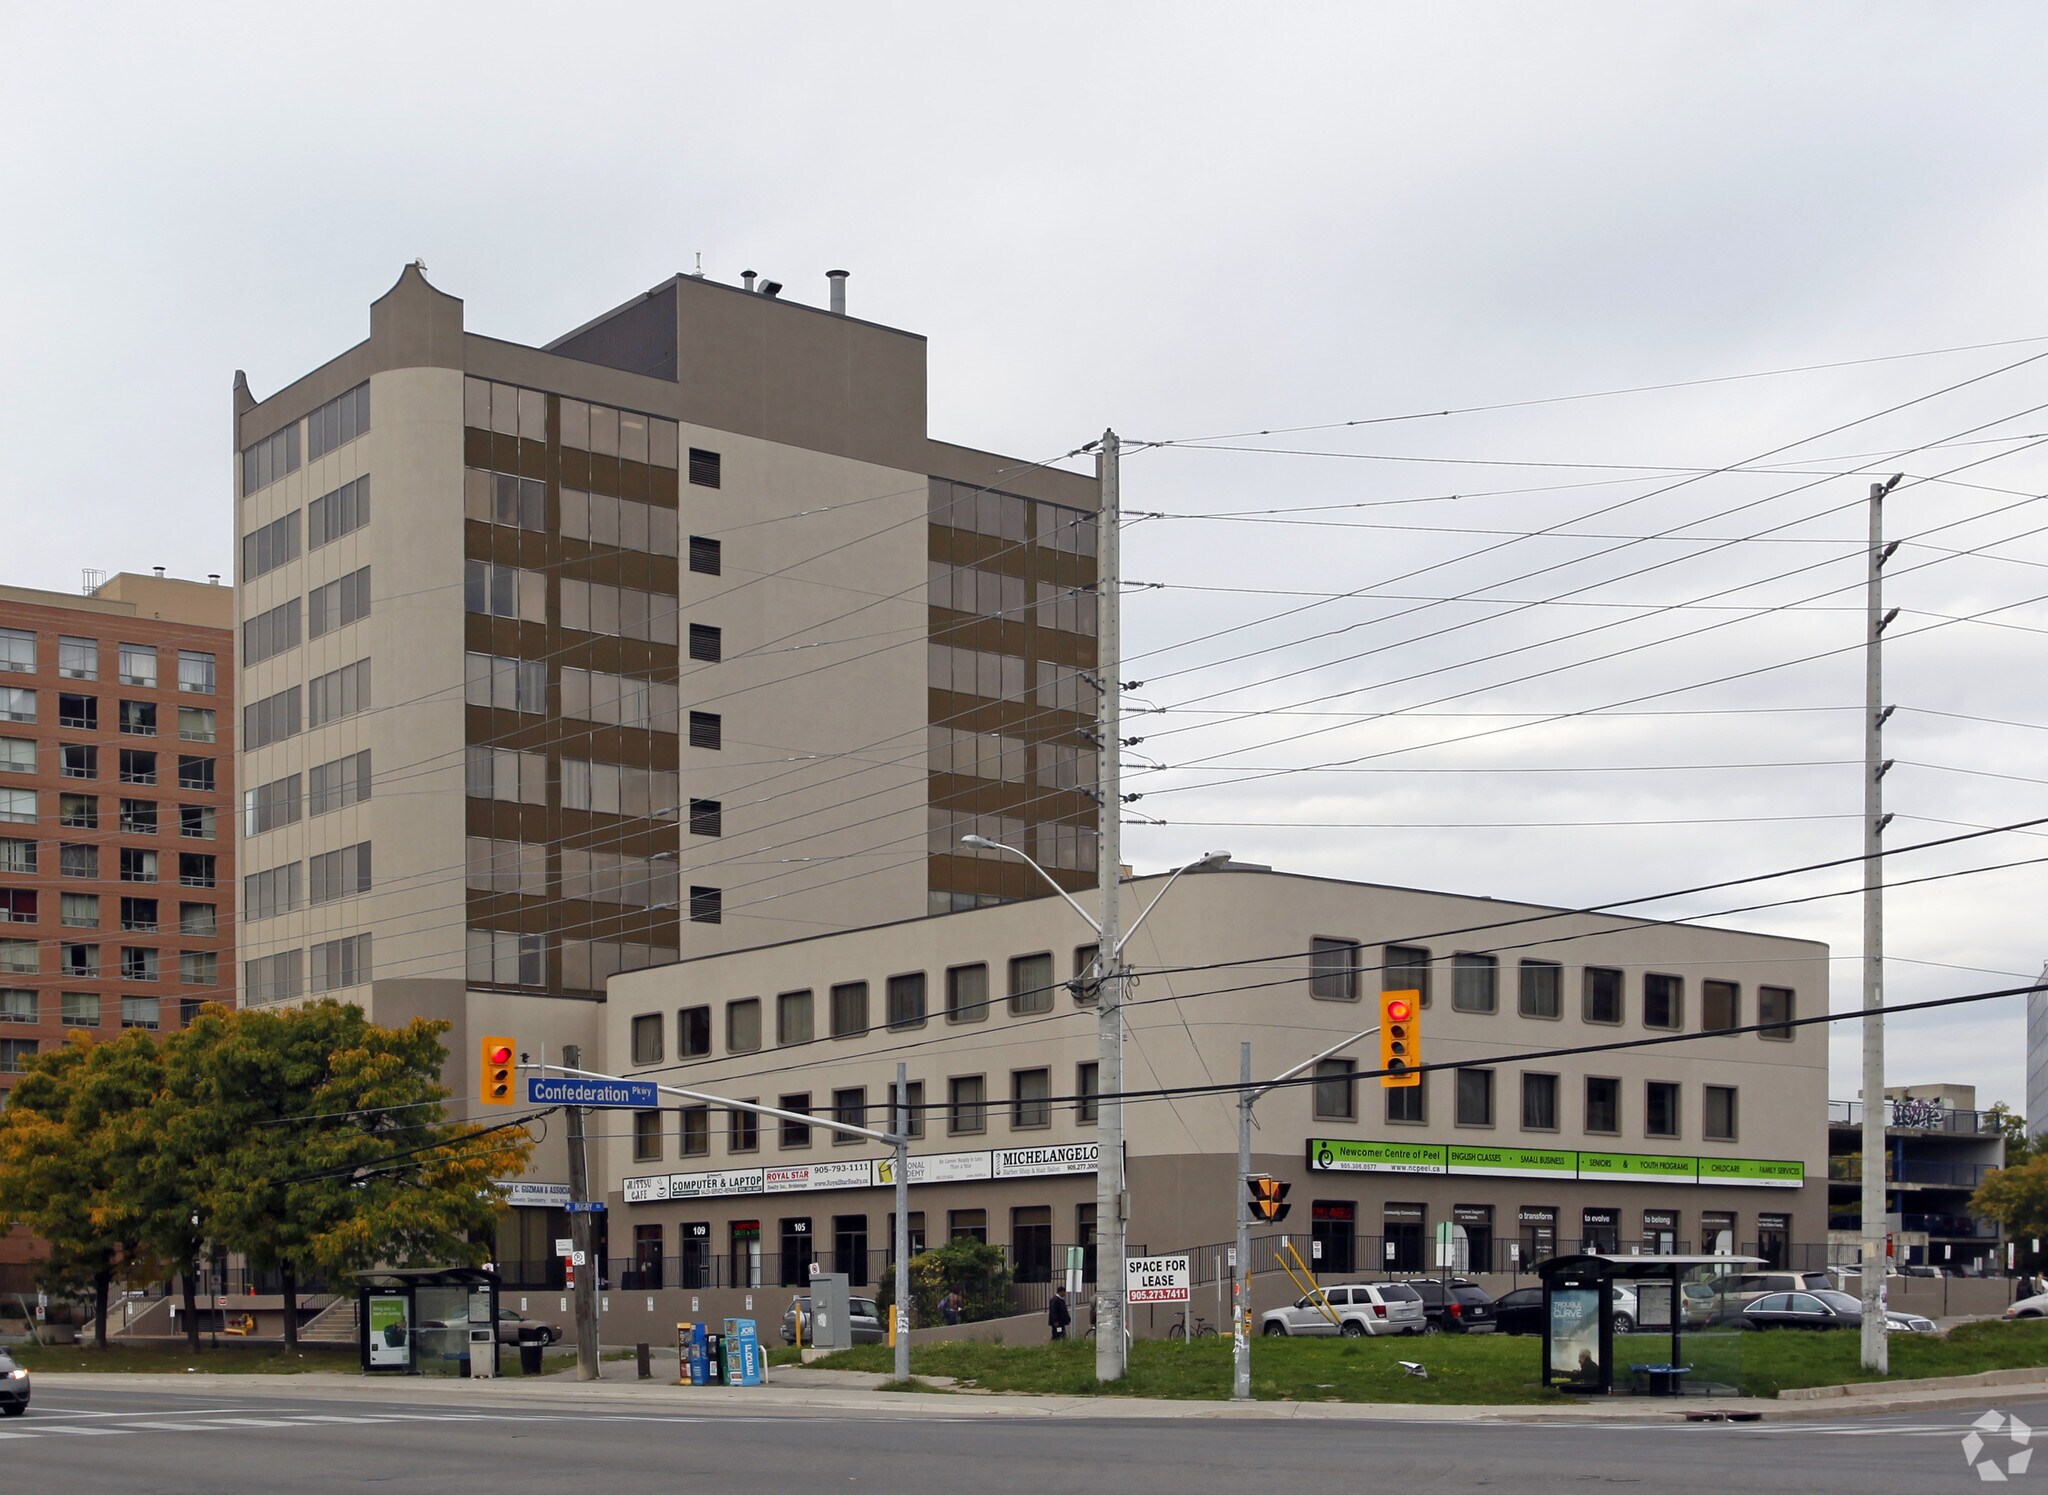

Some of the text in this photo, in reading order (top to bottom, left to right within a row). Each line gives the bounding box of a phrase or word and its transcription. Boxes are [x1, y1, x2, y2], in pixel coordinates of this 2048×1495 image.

[535, 1083, 652, 1102] Confederation Pkwy
[1003, 1146, 1099, 1166] MICHELANGELO
[1340, 1147, 1440, 1160] Newcomer Centre of Peel
[1451, 1152, 1502, 1162] ENGLISH CLASSES
[1520, 1155, 1565, 1165] SMALL BUSINESS
[1589, 1159, 1689, 1171] SENIORS & YOUTH PROGRAMS
[814, 1163, 869, 1174] 905-793-1111
[893, 1161, 925, 1170] NONAL
[1390, 1164, 1440, 1173] www.ncpeel.ca
[1711, 1164, 1740, 1173] CHILDCARE
[1759, 1166, 1800, 1175] FAMILY SERVICES
[766, 1170, 809, 1181] ROYAL STAR
[672, 1178, 717, 1191] COMPUTER
[720, 1178, 726, 1188] &
[729, 1175, 762, 1187] LAPTOP
[521, 1185, 544, 1194] GUZMAN
[544, 1186, 549, 1194] &
[549, 1186, 571, 1195] ASSOCIA
[631, 1190, 647, 1200] CAFE
[1524, 1212, 1553, 1221] transform
[1591, 1215, 1610, 1223] evolve
[1651, 1216, 1671, 1225] belong
[693, 1226, 706, 1236] 109
[794, 1223, 806, 1232] 105
[1129, 1260, 1186, 1273] SPACE FOR
[1142, 1275, 1174, 1286] LEASE
[1131, 1289, 1186, 1300] 905.273.7411
[745, 1344, 754, 1376] FREE
